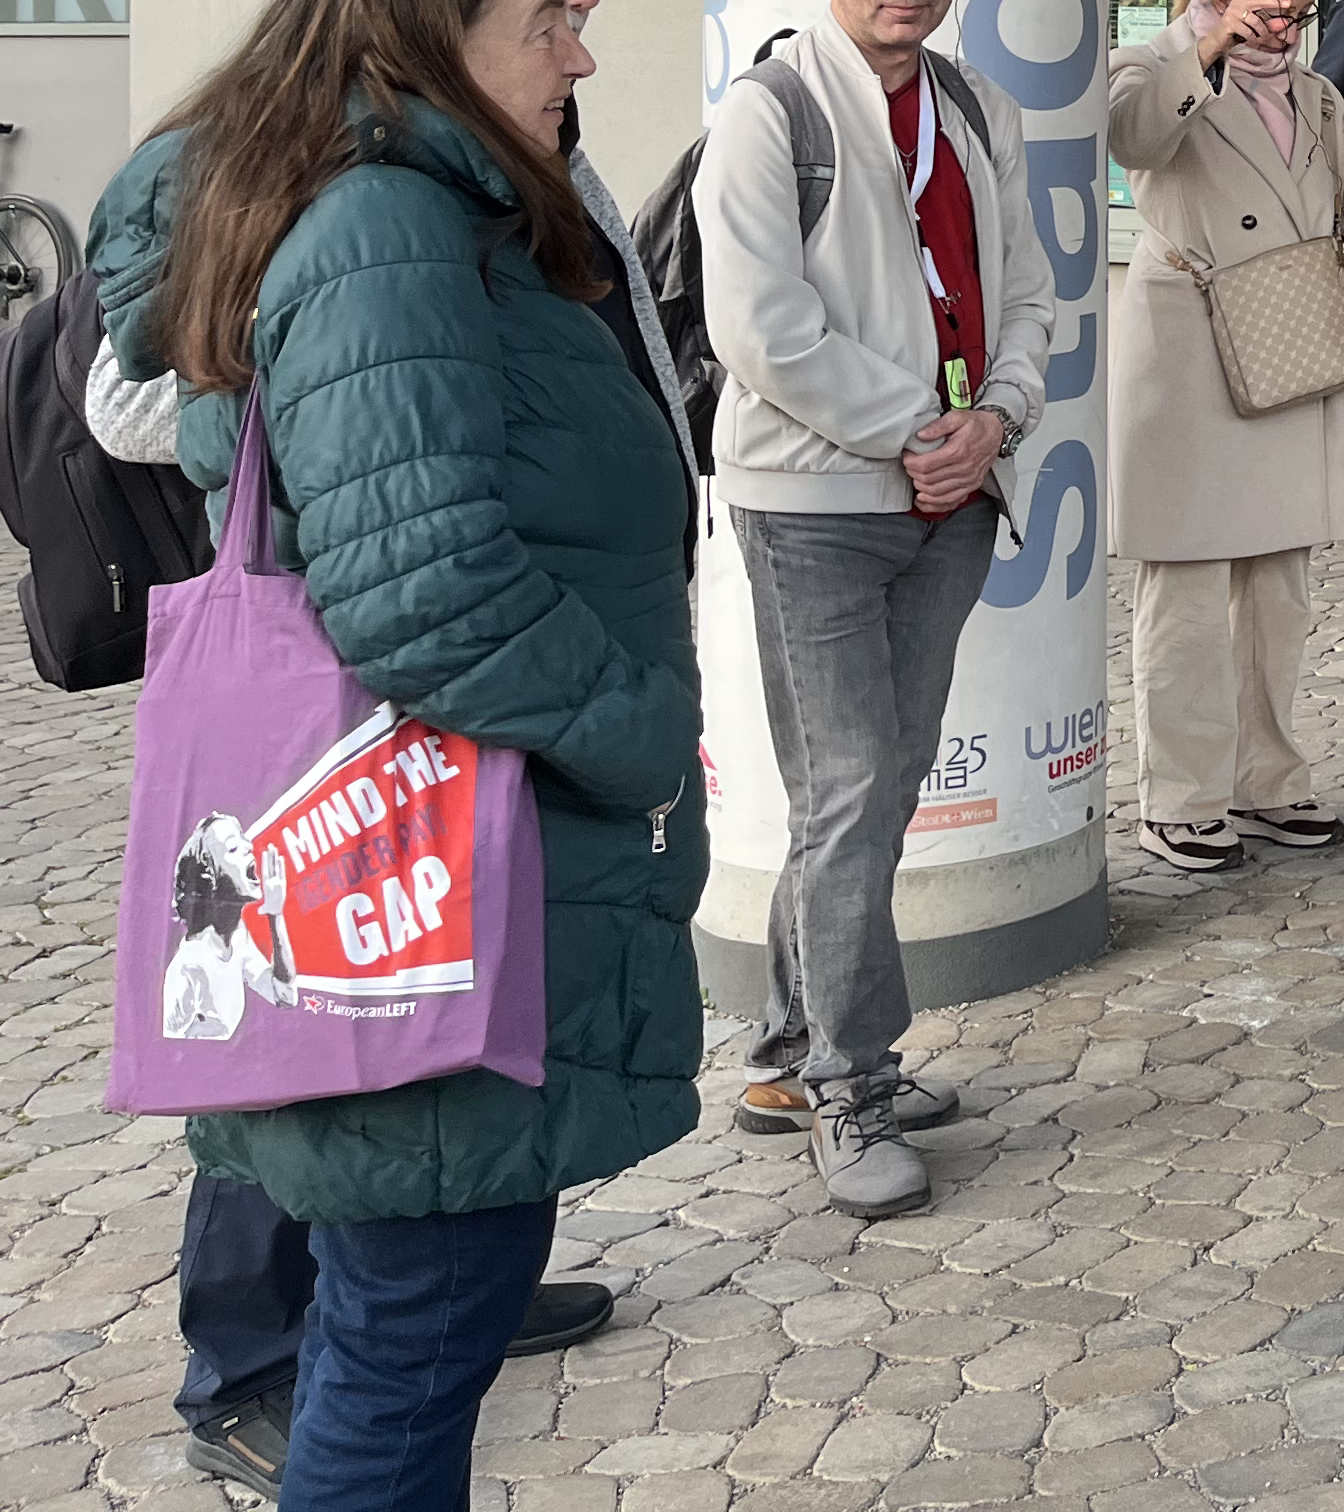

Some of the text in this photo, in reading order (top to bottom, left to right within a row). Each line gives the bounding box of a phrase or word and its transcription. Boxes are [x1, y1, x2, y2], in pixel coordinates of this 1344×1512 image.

[945, 734, 988, 774] 25
[1047, 742, 1099, 780] unser
[281, 735, 461, 874] MIND THE
[335, 855, 452, 966] GAP
